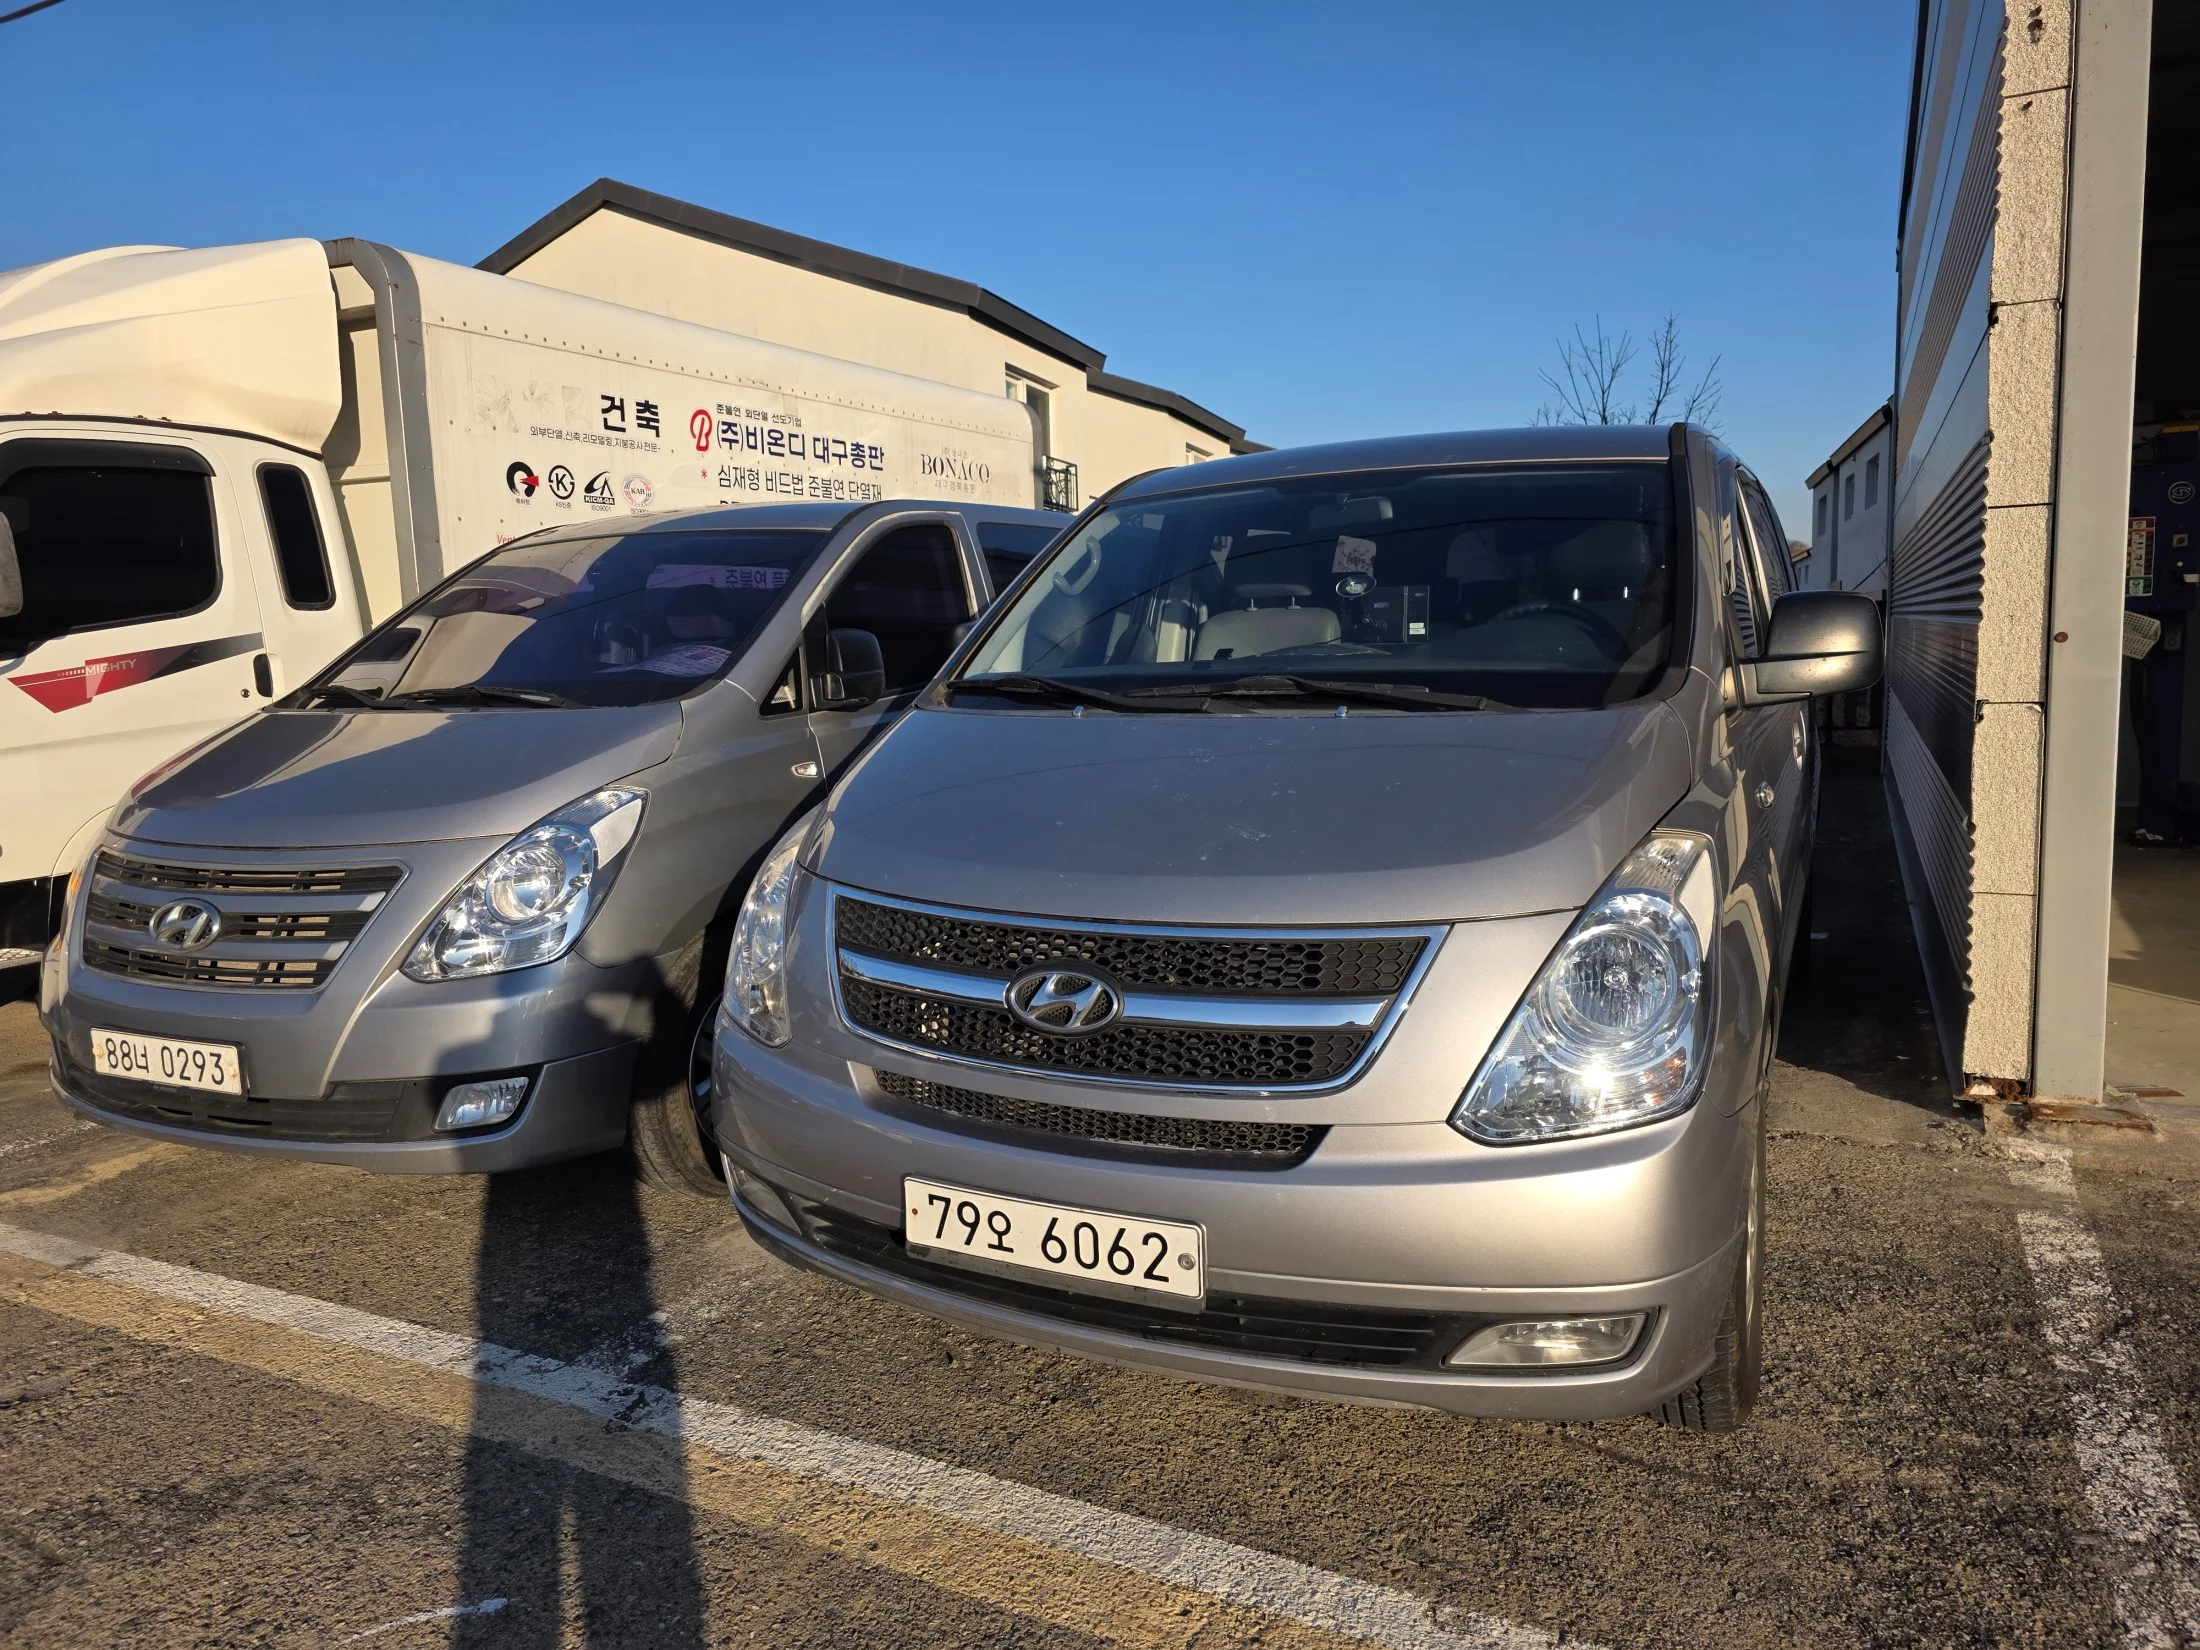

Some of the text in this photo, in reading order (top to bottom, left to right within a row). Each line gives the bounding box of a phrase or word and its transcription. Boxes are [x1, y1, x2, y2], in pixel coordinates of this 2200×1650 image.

[771, 413, 802, 428] 선도기업
[716, 420, 885, 472] (주)비온디 대구총판
[717, 464, 882, 501] 심재형 비드법 준불연 단열재
[920, 453, 990, 484] BONACO
[85, 659, 137, 676] MIGHTY
[105, 1037, 225, 1085] 88너 0293
[927, 1193, 1170, 1283] 79오 6062
